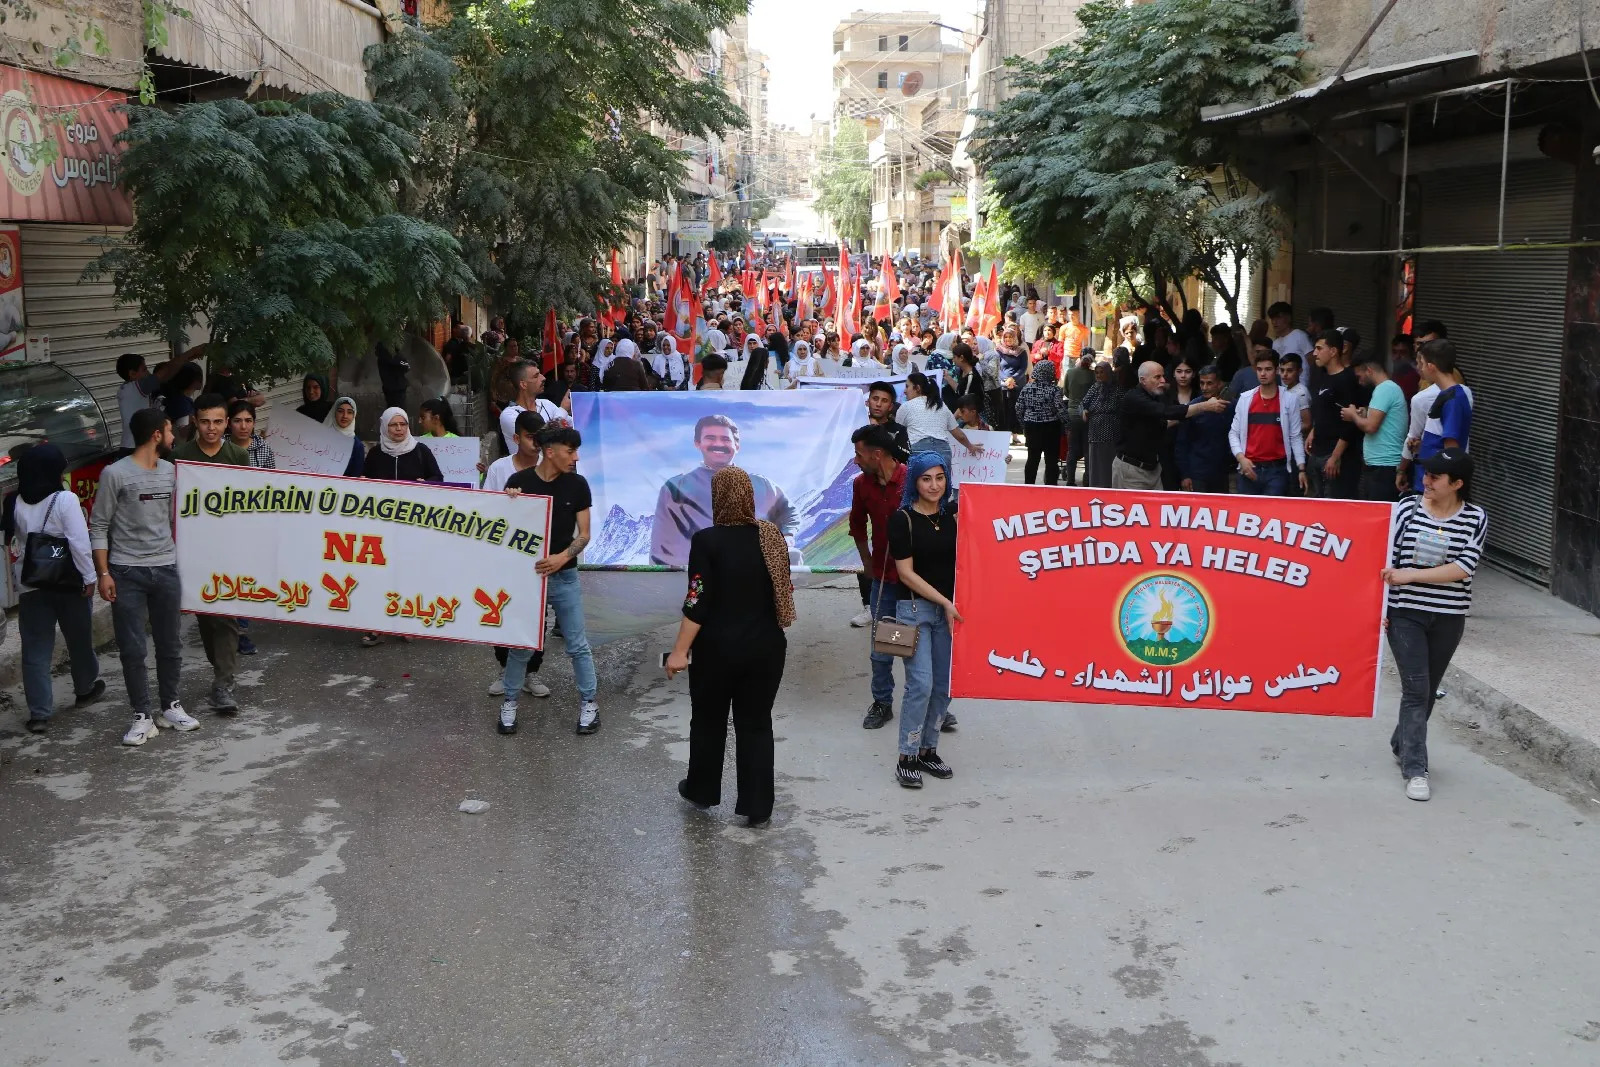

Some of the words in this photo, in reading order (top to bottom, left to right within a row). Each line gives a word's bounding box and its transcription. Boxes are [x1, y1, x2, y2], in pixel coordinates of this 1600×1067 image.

[66, 120, 98, 144] فروج
[7, 168, 42, 192] CHICKENS
[318, 487, 337, 513] Û
[507, 528, 544, 556] RE
[992, 498, 1149, 542] MECLÎSA
[1160, 504, 1352, 562] MALBATÊN
[323, 532, 387, 565] NA
[1018, 536, 1141, 578] ŞEHÎDA
[1151, 541, 1192, 567] YA
[1202, 545, 1311, 588] HELEB
[201, 573, 312, 613] للإحتلال
[321, 572, 358, 611] لا
[384, 591, 461, 627] لإبادة
[474, 586, 511, 625] لا
[988, 648, 1046, 679] حلب
[1144, 645, 1178, 660] M.M.Ş
[1071, 662, 1172, 696] الشهداء
[1180, 668, 1253, 701] عوائل
[1264, 662, 1340, 697] مجلس
